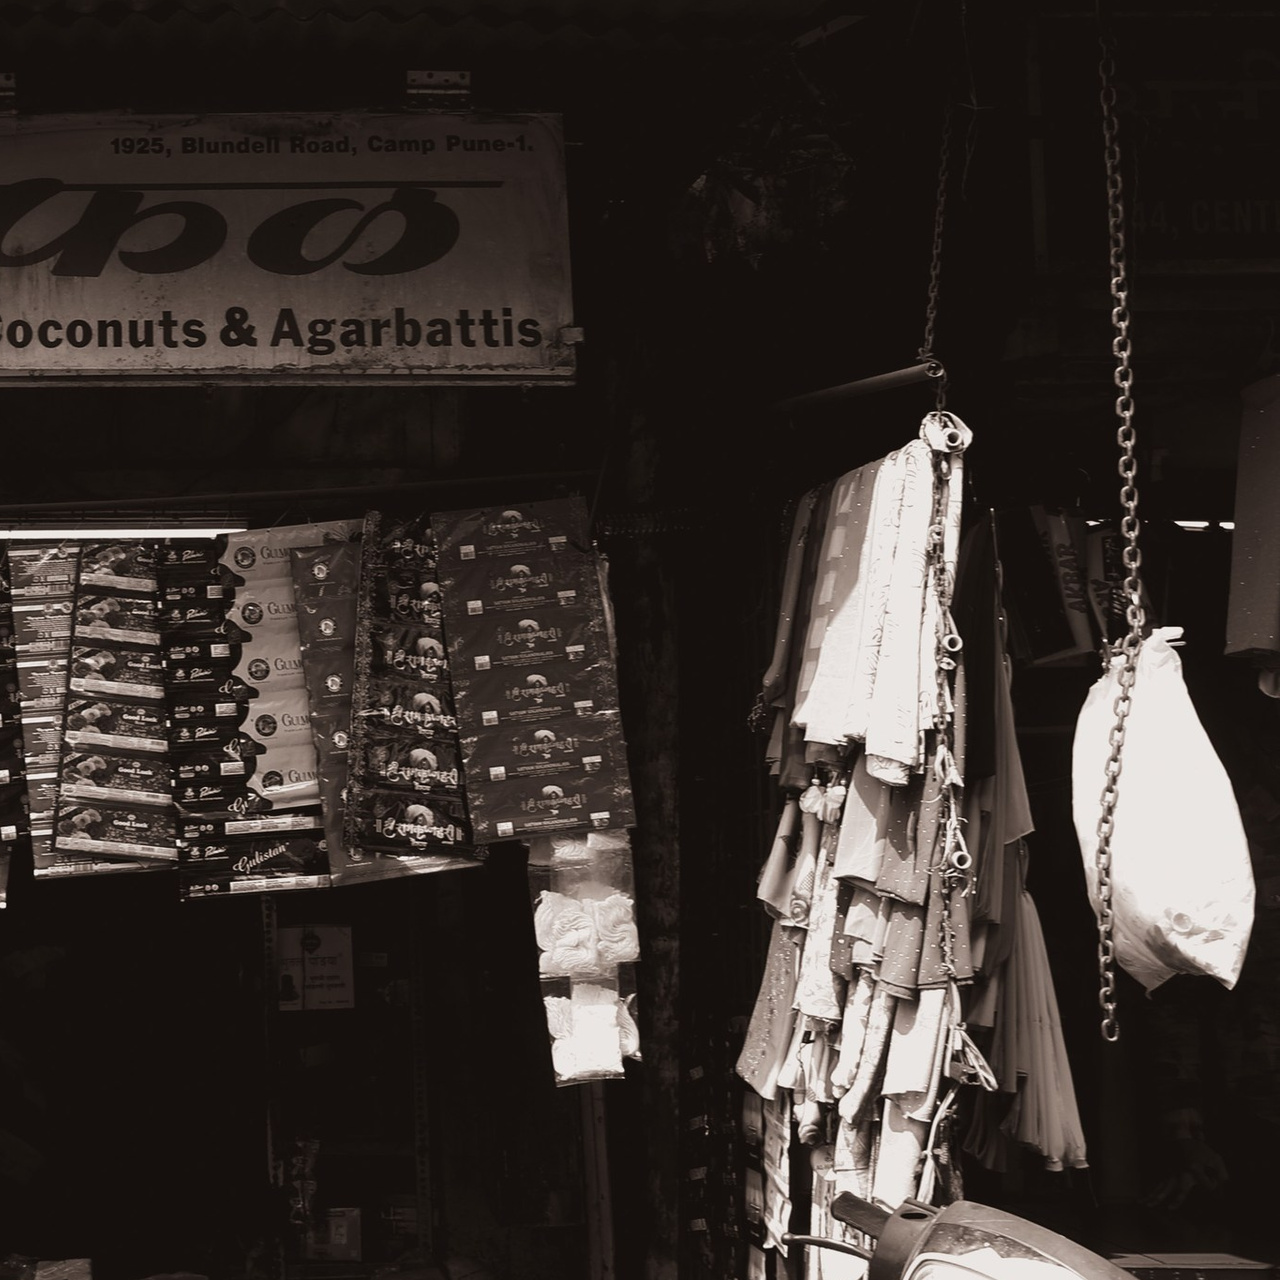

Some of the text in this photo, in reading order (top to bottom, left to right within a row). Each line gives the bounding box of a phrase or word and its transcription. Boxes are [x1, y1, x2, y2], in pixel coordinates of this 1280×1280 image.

[110, 134, 533, 157] 1925, Blundell Road, Camp Pune-1.
[219, 307, 258, 348] &
[270, 307, 543, 355] Agarbattis
[232, 843, 287, 874] Gulistan
